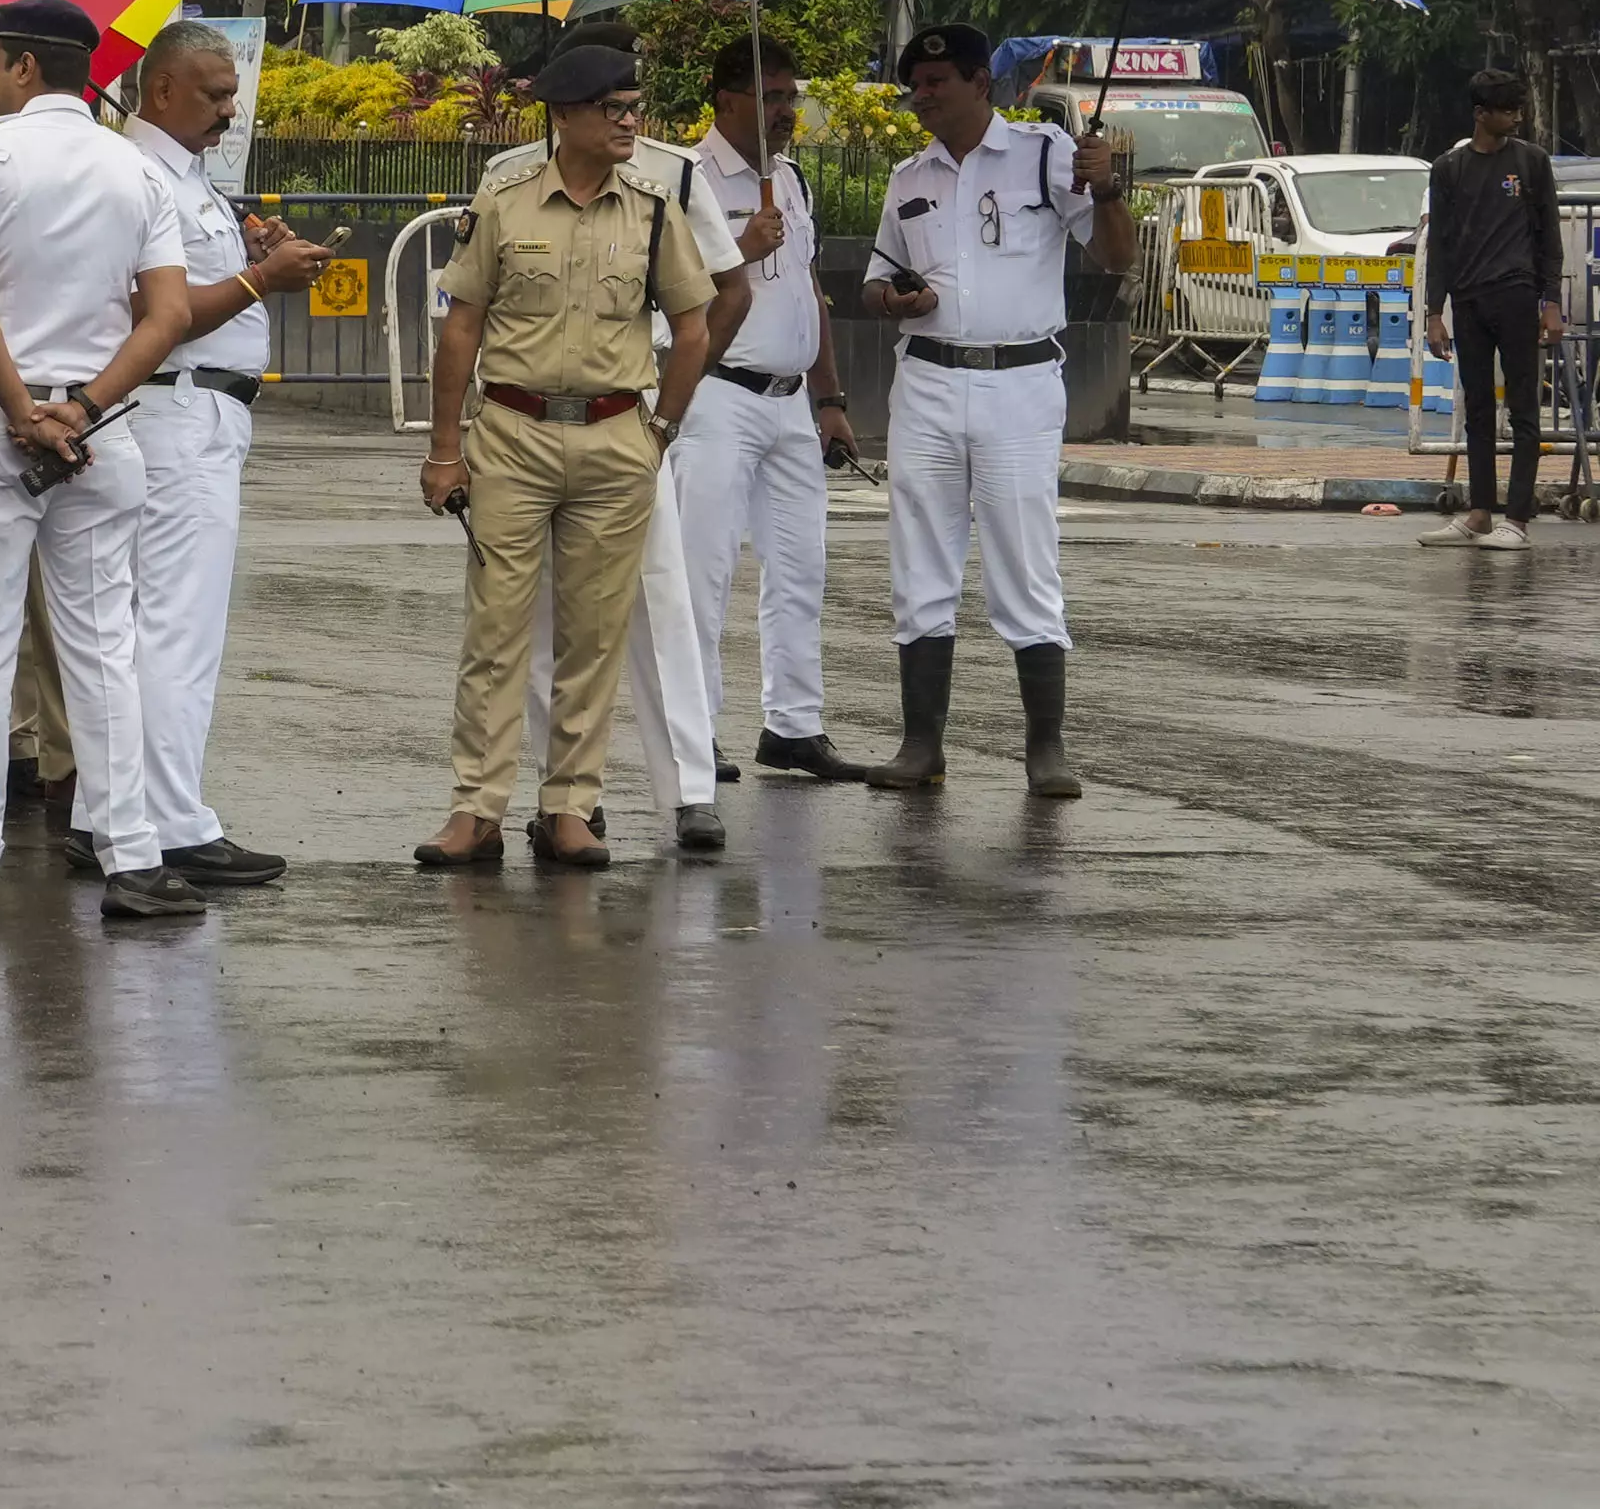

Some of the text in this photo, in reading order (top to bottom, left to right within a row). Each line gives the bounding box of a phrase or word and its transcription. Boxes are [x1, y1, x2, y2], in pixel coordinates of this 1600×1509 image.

[1115, 51, 1180, 72] KING
[1282, 324, 1298, 332] KP
[1349, 326, 1364, 335] KP
